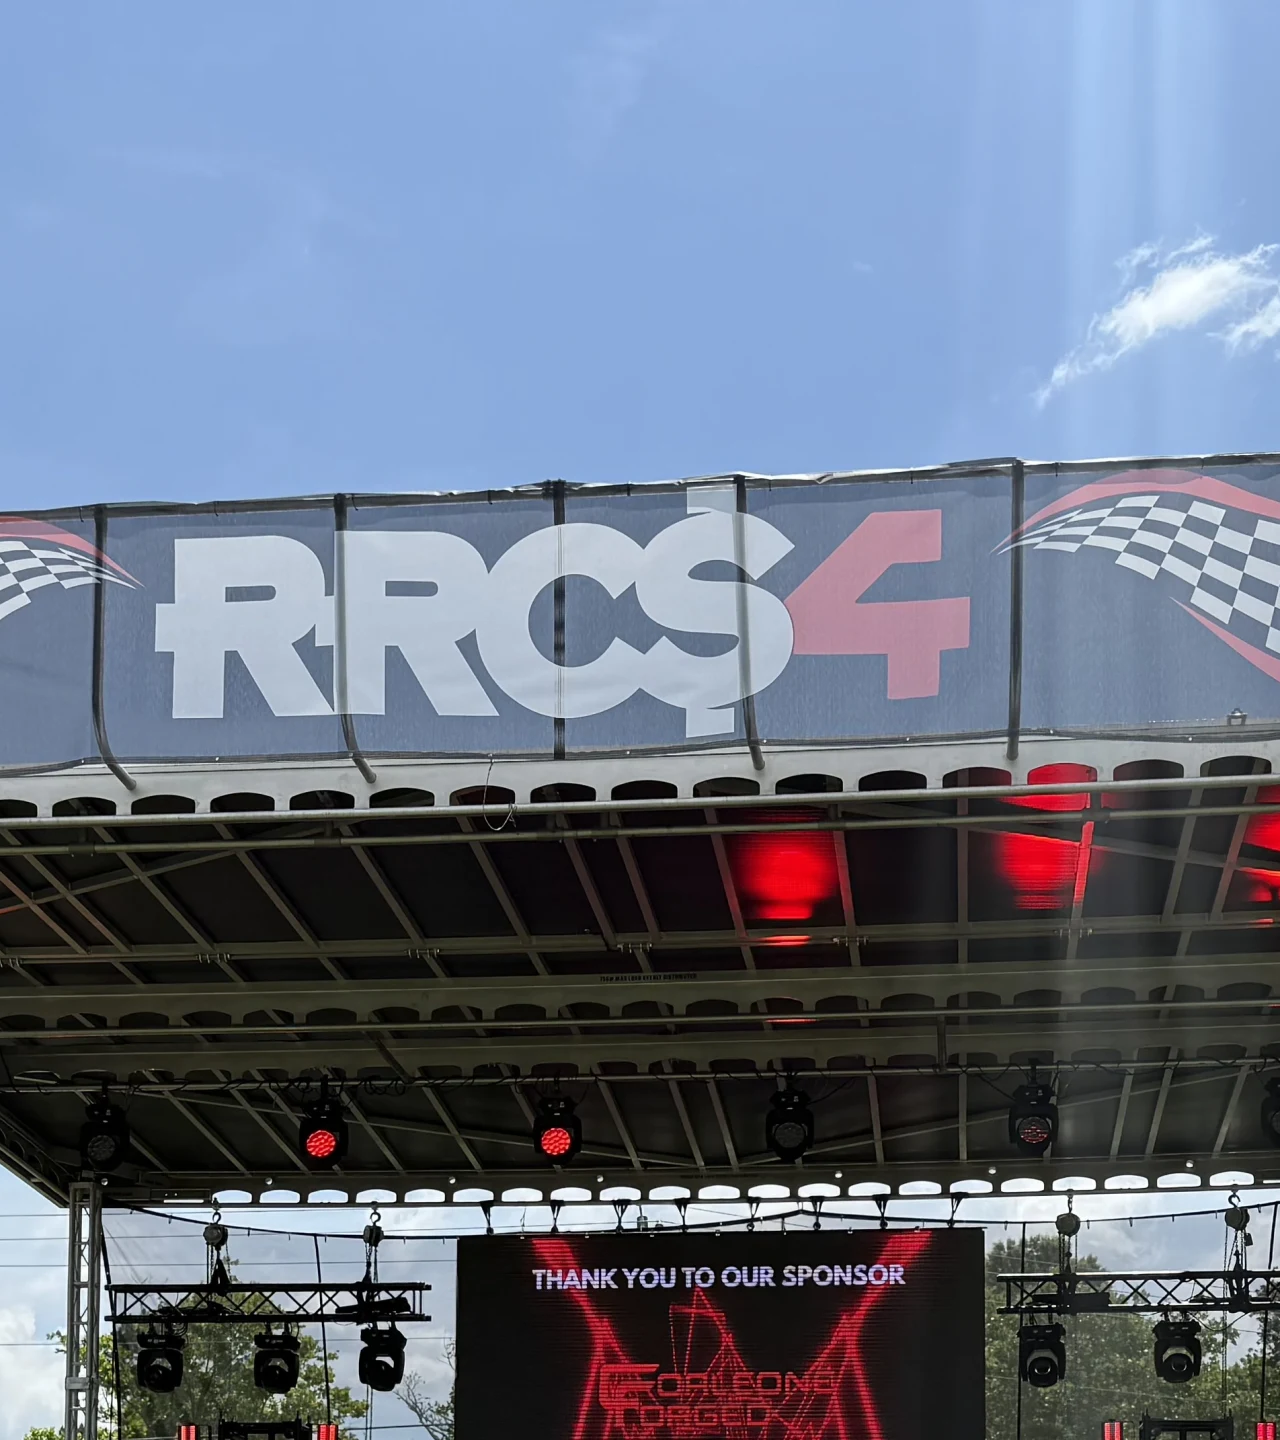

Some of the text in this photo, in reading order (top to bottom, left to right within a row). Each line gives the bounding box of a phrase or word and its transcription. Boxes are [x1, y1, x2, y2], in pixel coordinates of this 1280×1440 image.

[532, 1264, 906, 1290] THANK YOU TO OUR SPONSOR
